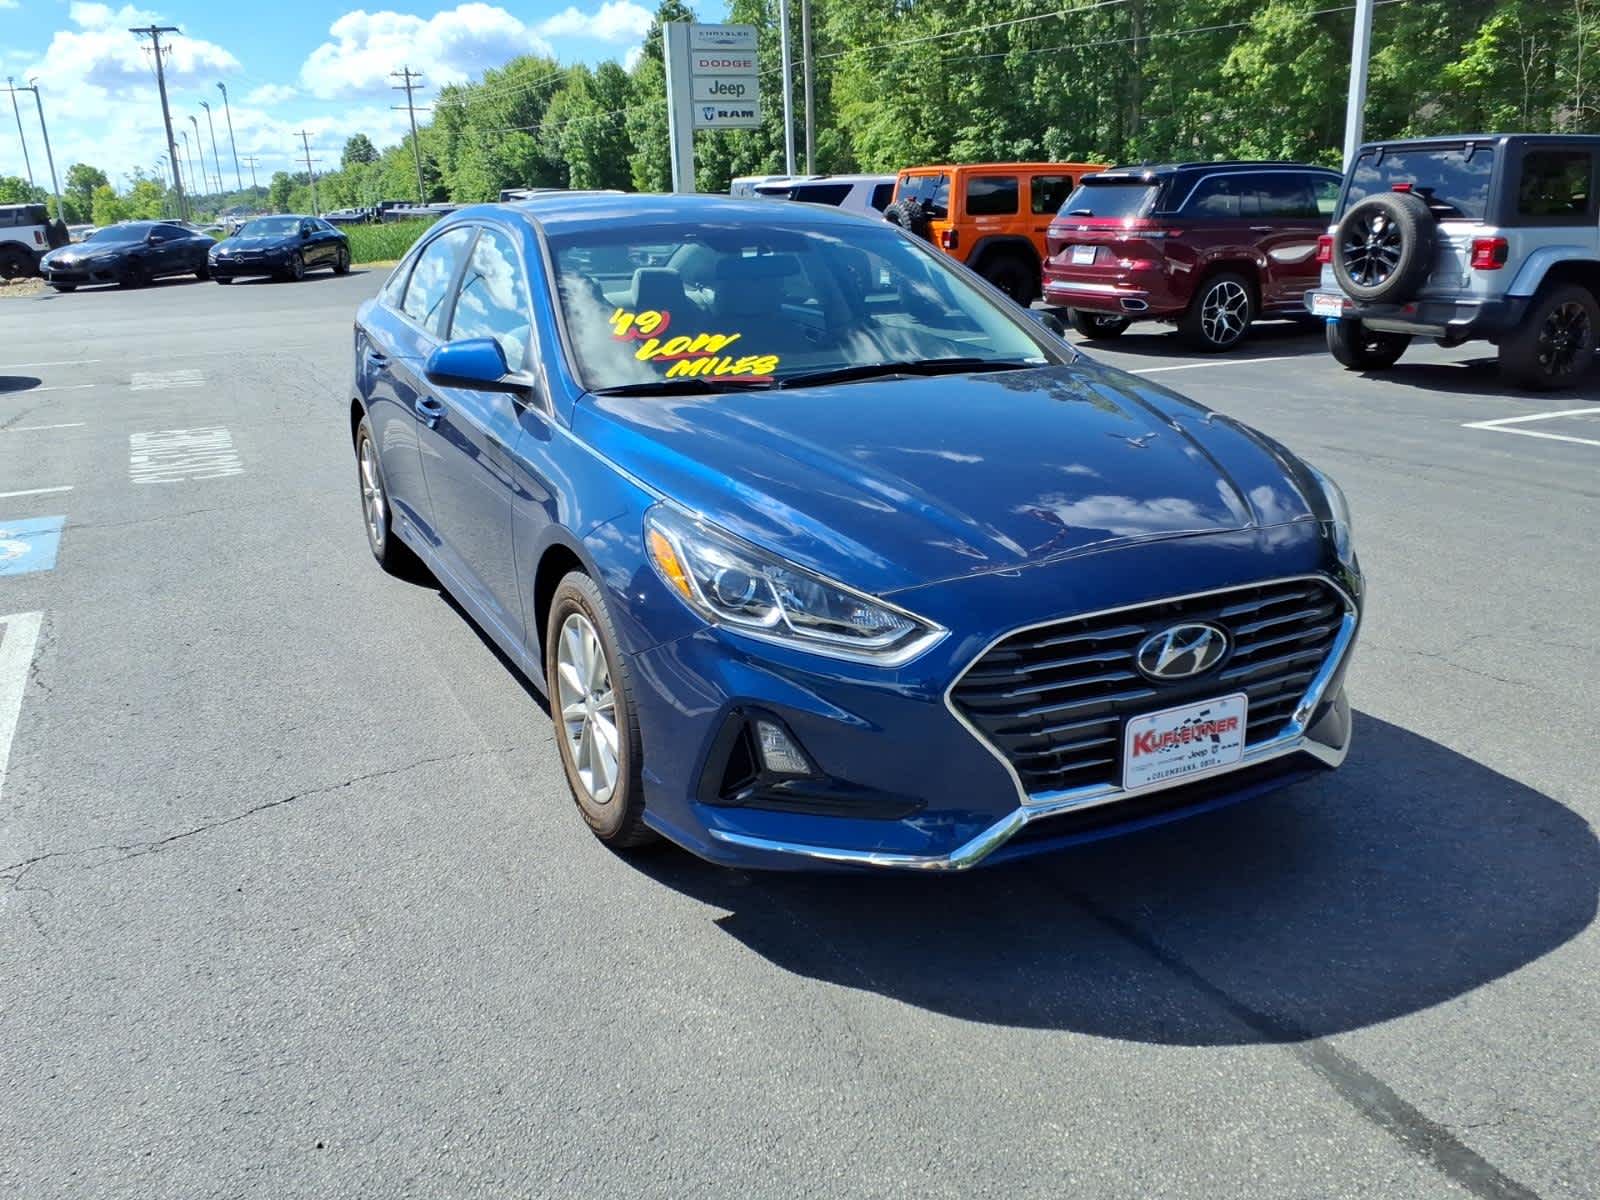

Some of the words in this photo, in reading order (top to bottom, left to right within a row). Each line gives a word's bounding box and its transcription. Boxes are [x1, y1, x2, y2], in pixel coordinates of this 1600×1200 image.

[699, 59, 752, 67] DODGE
[709, 80, 745, 97] Jeep
[718, 110, 755, 118] RAM
[635, 332, 741, 361] LOW
[665, 355, 780, 378] MILES
